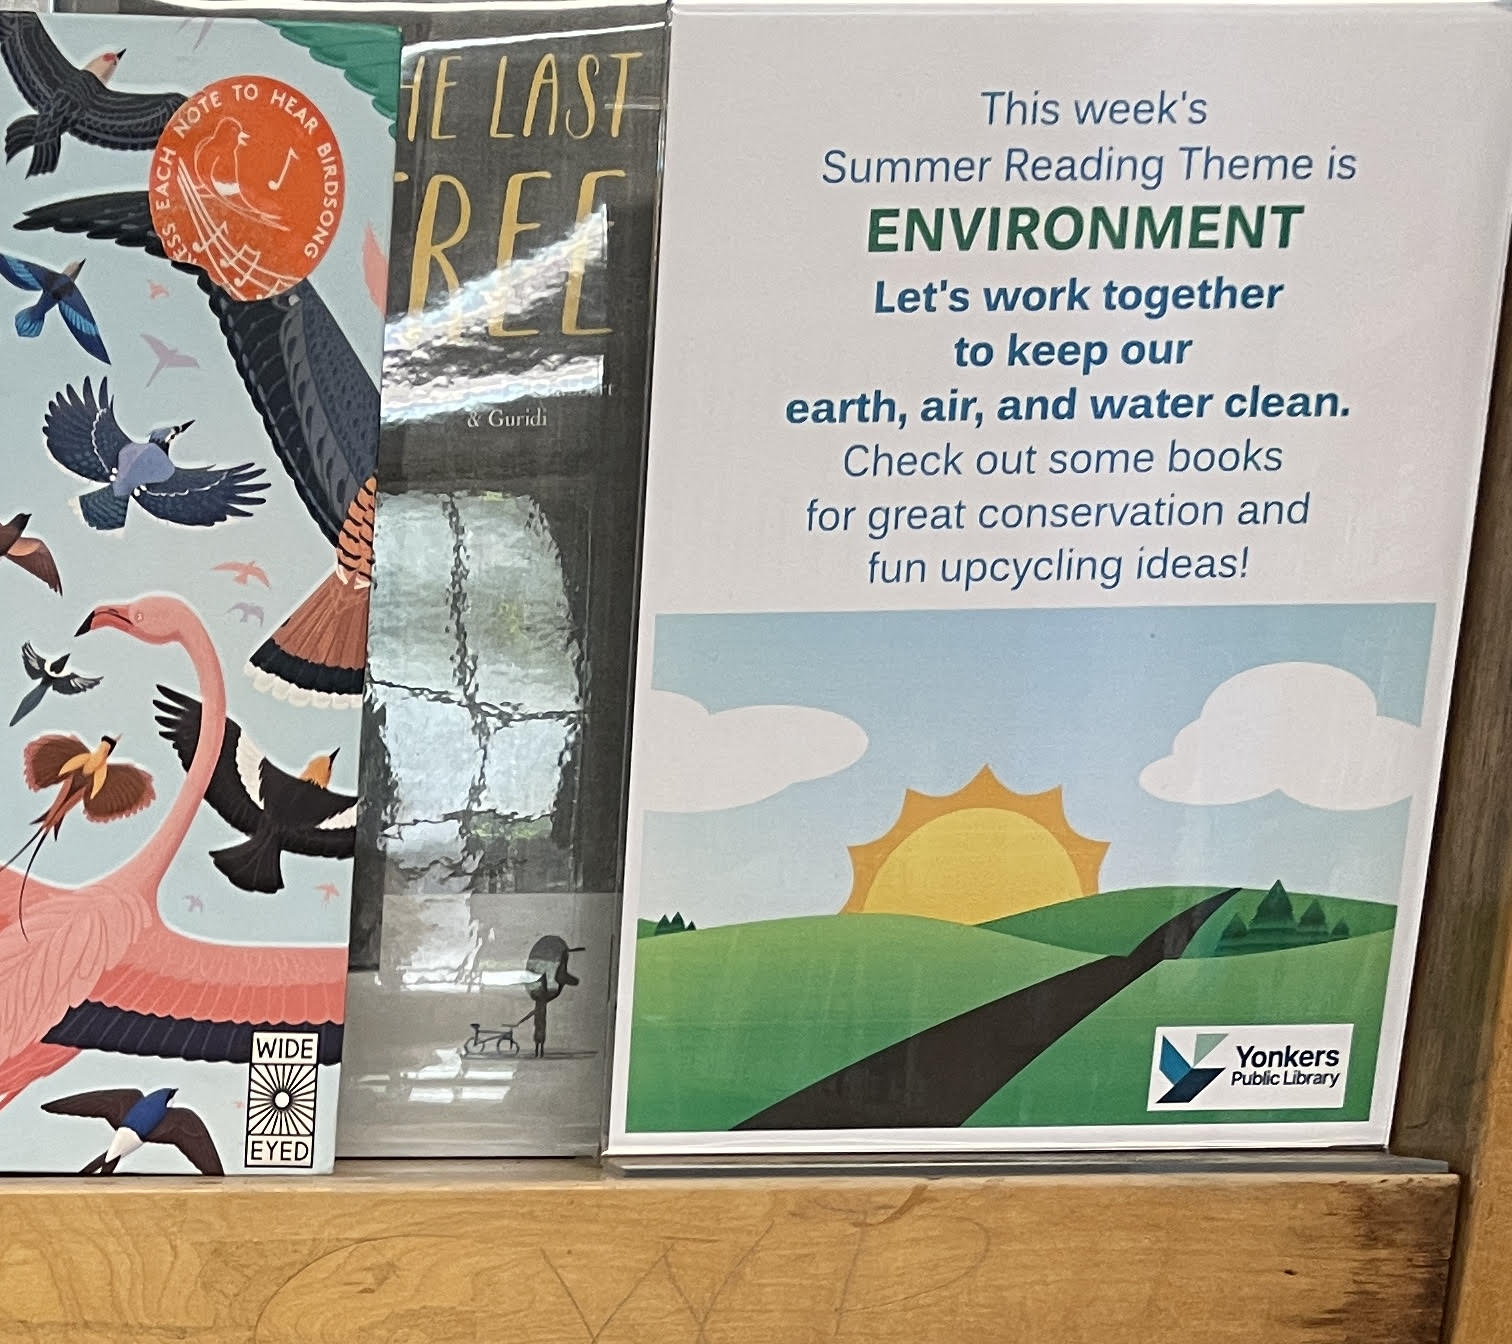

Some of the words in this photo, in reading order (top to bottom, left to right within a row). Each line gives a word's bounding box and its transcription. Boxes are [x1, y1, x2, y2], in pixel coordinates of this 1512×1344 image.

[490, 52, 642, 139] LAST
[156, 148, 176, 209] EACH
[174, 91, 223, 139] NOTE
[232, 84, 259, 101] TO
[271, 90, 318, 136] HEAR
[304, 141, 339, 259] BIRDSONG
[867, 204, 1305, 254] ENVIRONMENT
[488, 409, 547, 428] Guridi
[785, 389, 908, 431] earth,
[919, 389, 986, 430] air,
[997, 387, 1076, 422] and
[1089, 391, 1213, 421] water
[1223, 384, 1351, 420] clean.
[807, 497, 856, 533] for
[868, 500, 966, 541] great
[978, 494, 1225, 529] conservation
[1237, 493, 1309, 527] and
[869, 550, 926, 586] fun
[940, 548, 1124, 592] upcycling
[1135, 548, 1250, 583] ideas!
[256, 1037, 315, 1060] WIDE
[1236, 1046, 1339, 1068] Yonkers
[1231, 1071, 1280, 1086] Public
[1283, 1071, 1339, 1088] Library
[250, 1139, 310, 1162] EYED
